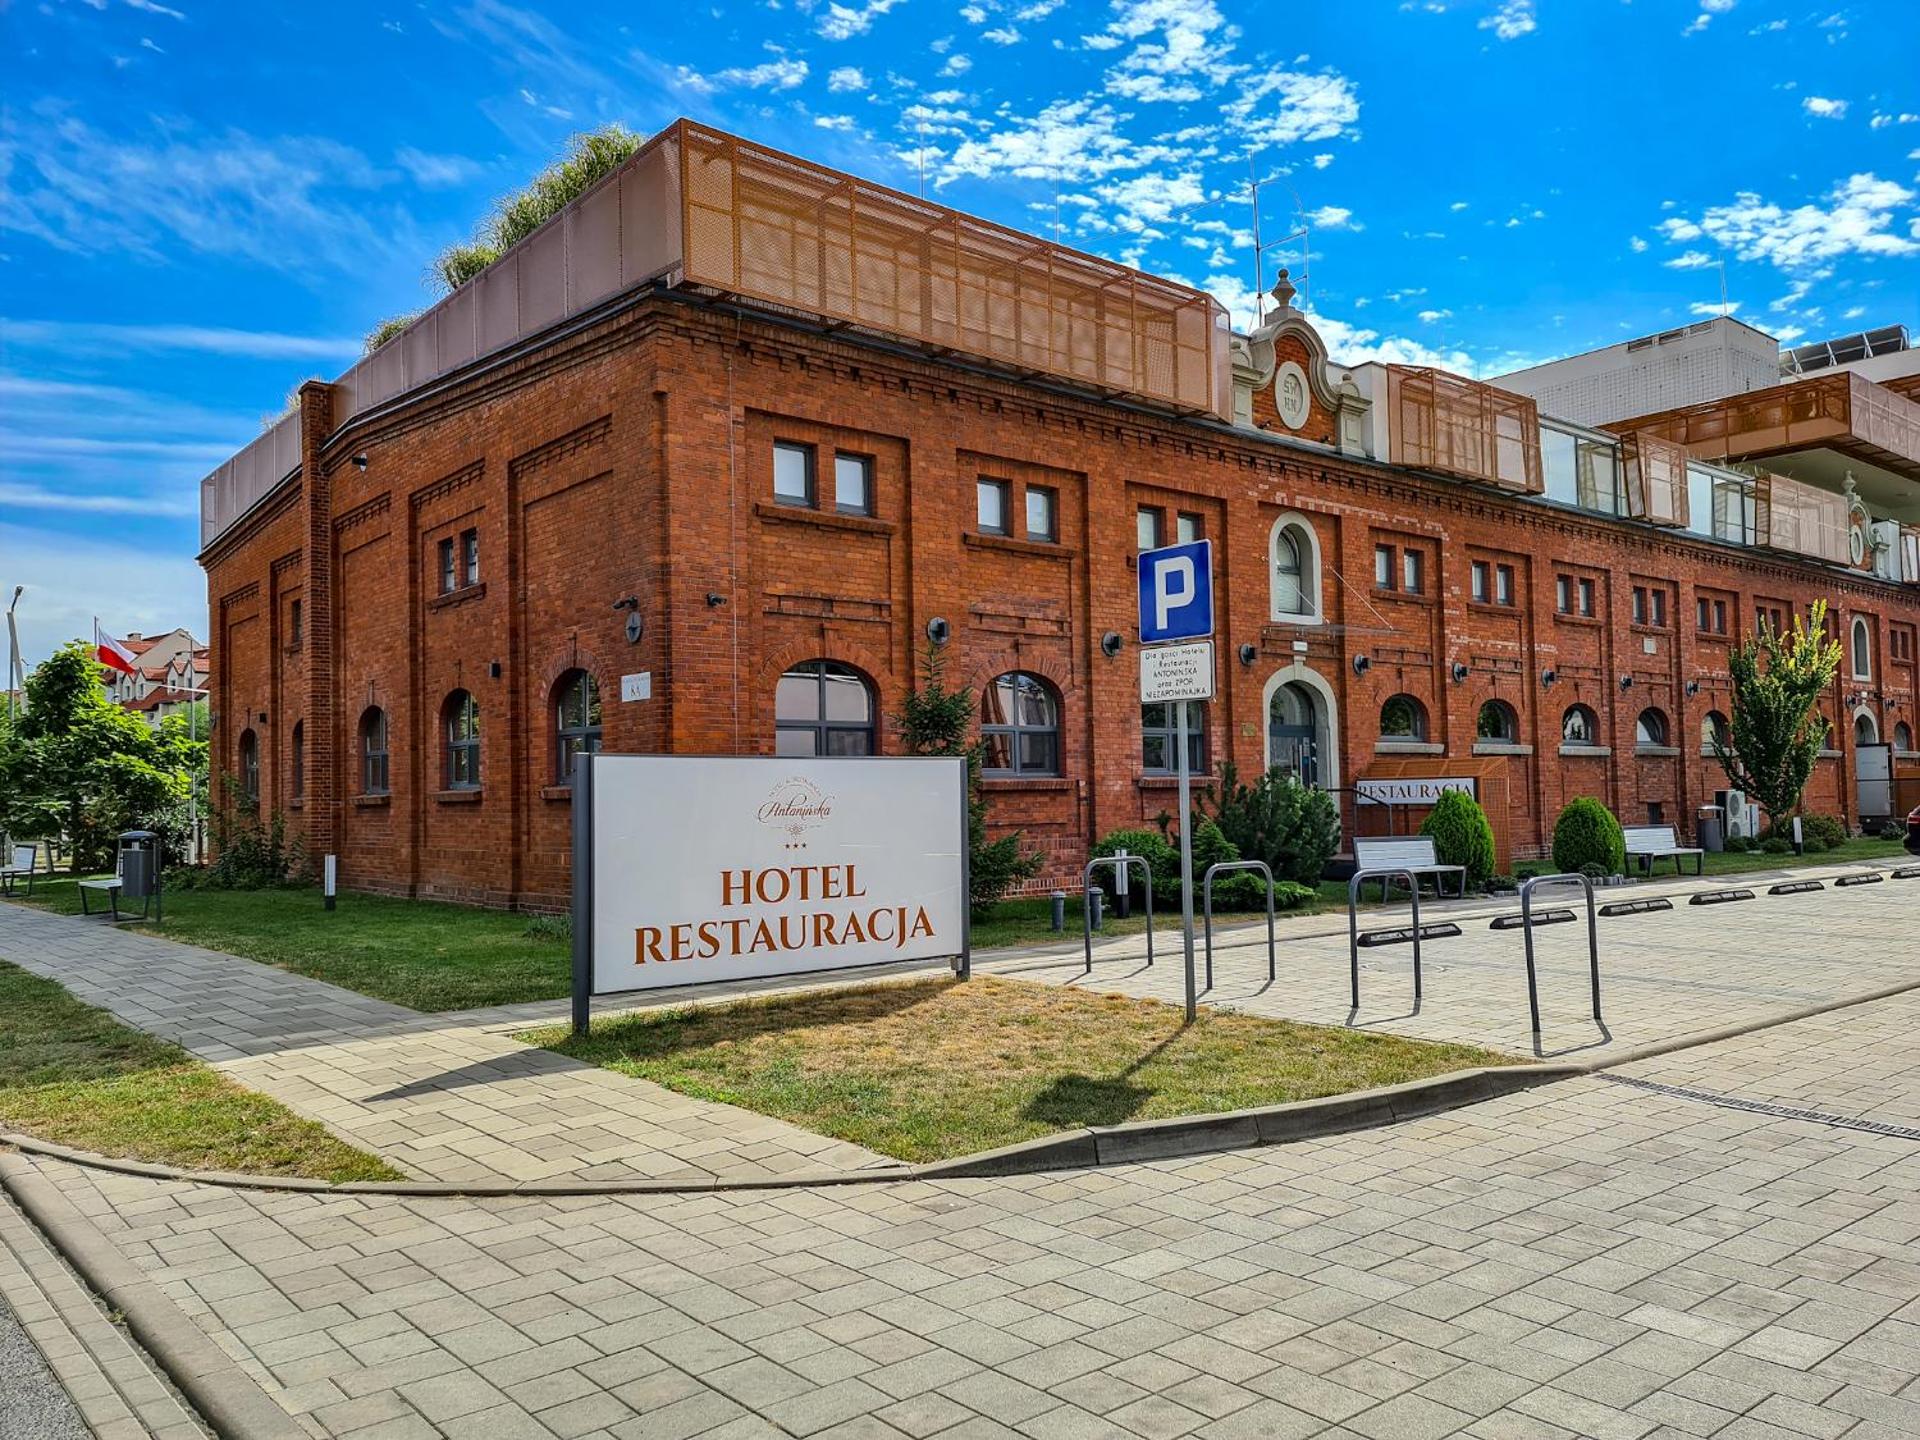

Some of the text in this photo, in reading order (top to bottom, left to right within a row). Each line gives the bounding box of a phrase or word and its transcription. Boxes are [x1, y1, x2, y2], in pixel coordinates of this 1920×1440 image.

[1155, 556, 1195, 630] P
[720, 864, 867, 906] HOTEL
[634, 905, 936, 965] RESTAURACJA
